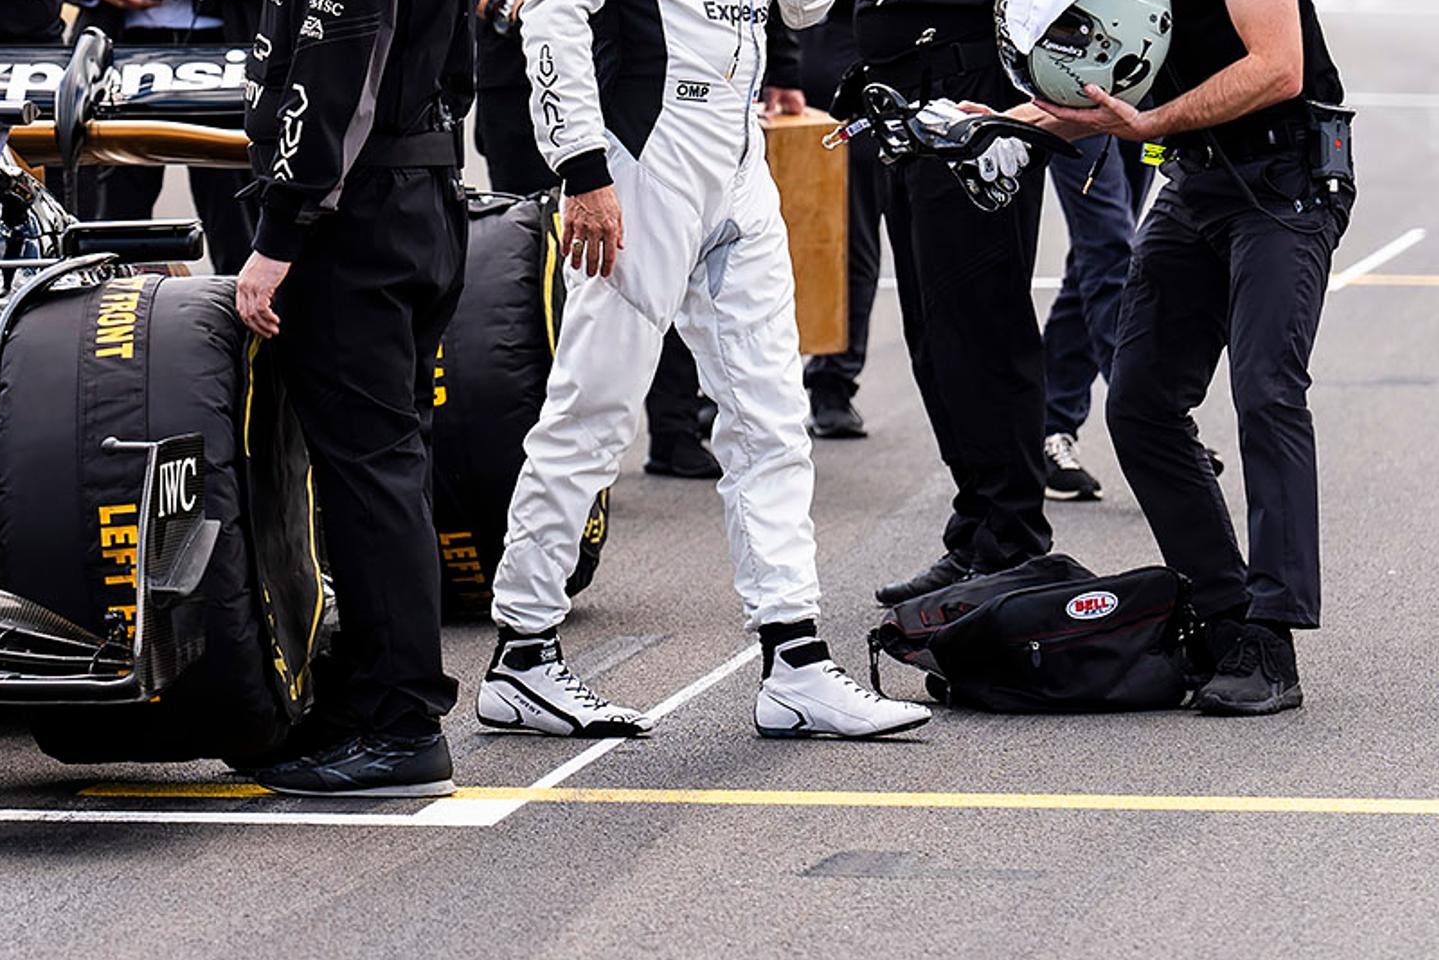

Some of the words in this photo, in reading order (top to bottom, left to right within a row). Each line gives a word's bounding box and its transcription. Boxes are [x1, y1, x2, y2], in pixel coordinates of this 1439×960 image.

[675, 81, 710, 102] OMP
[157, 456, 197, 518] IWC
[97, 503, 138, 589] LEFT
[1074, 597, 1109, 612] BELL
